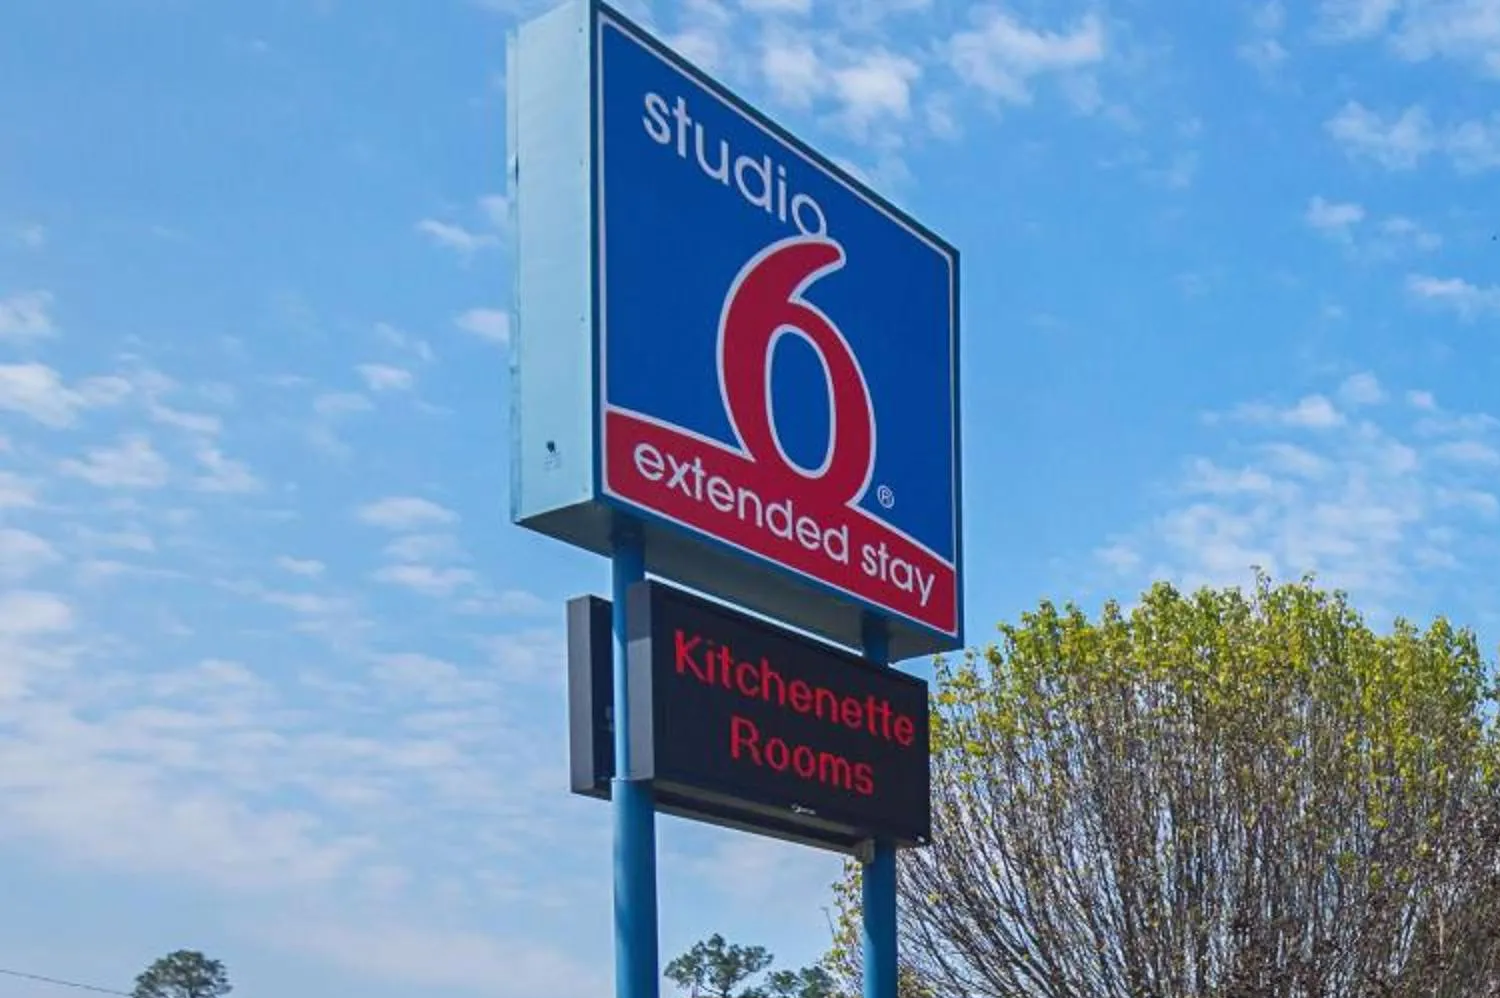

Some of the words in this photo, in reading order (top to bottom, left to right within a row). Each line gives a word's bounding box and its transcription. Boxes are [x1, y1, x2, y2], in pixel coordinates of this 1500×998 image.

[642, 91, 828, 237] studio
[716, 235, 876, 508] 6
[633, 444, 850, 563] extended
[861, 545, 936, 607] stay
[674, 629, 916, 746] Kitchenette
[730, 714, 875, 796] Rooms
